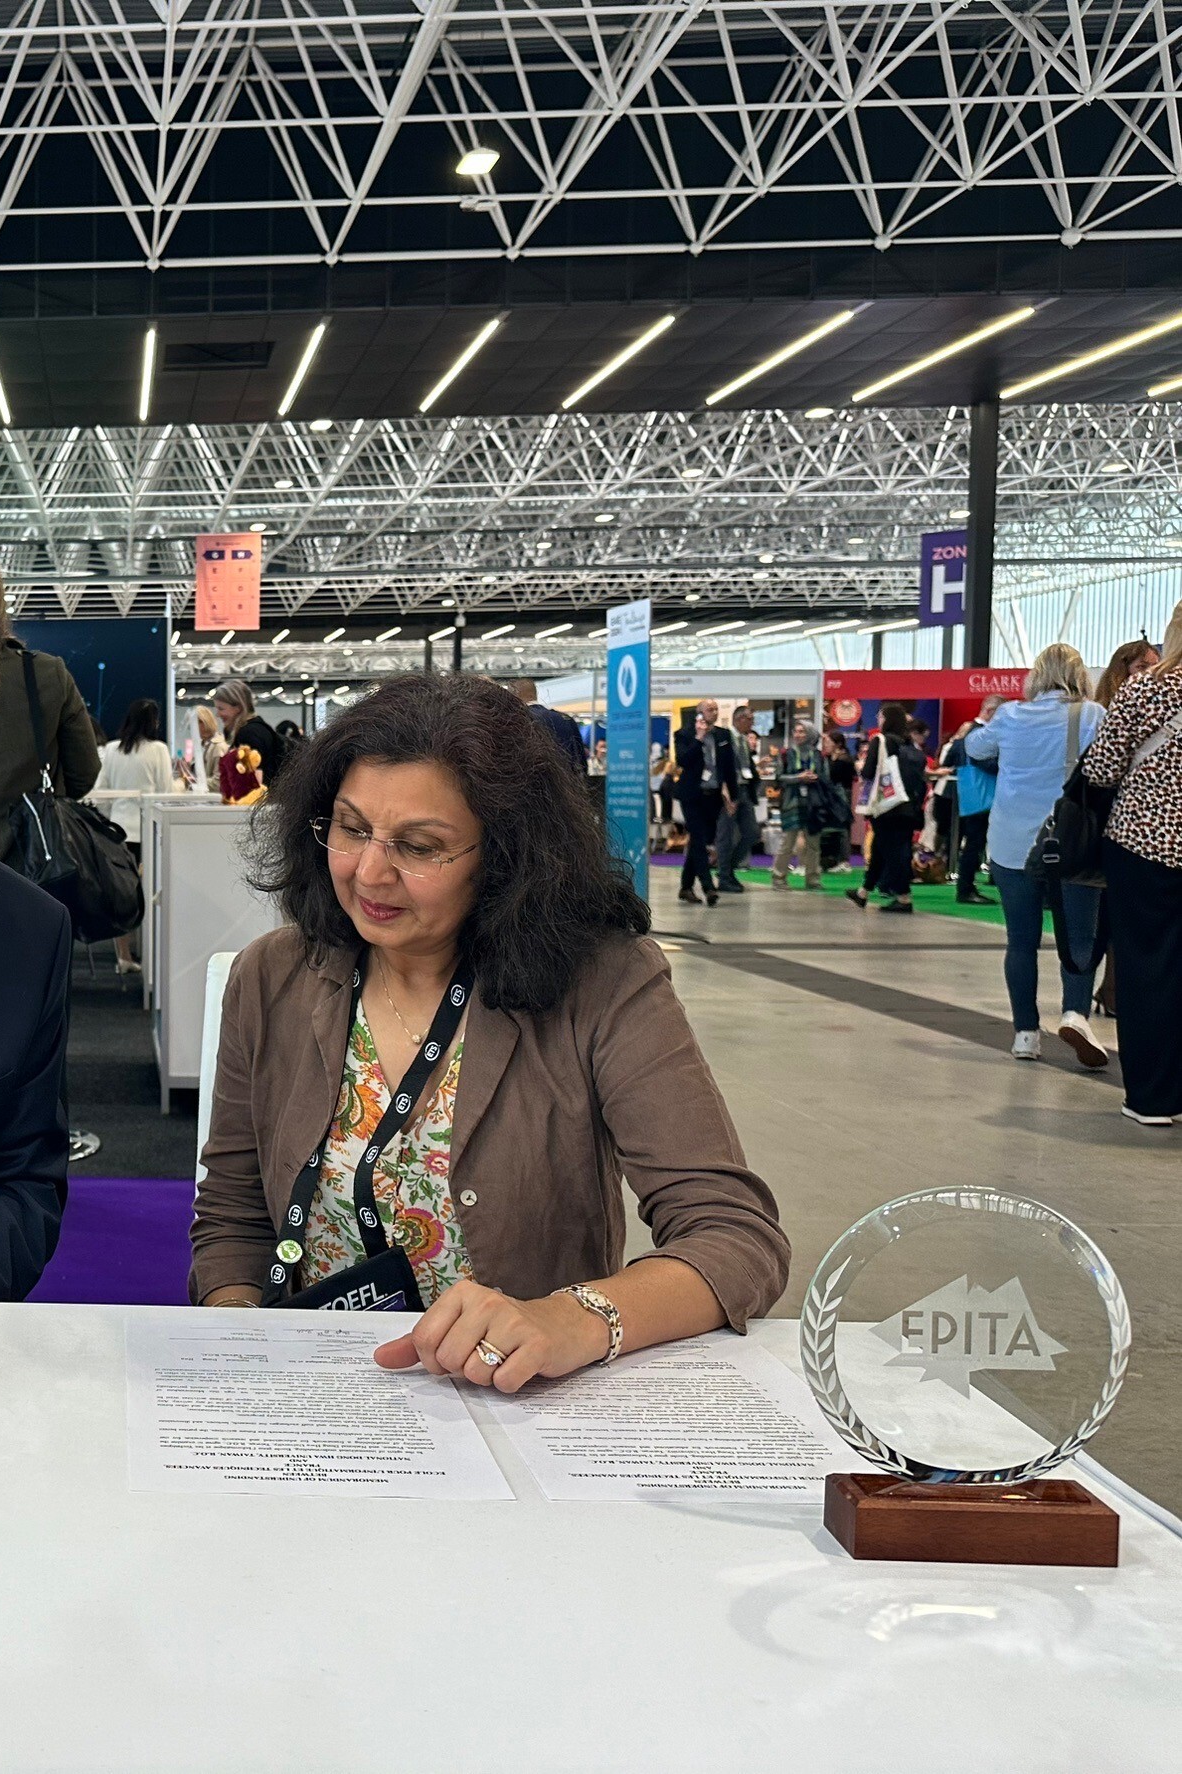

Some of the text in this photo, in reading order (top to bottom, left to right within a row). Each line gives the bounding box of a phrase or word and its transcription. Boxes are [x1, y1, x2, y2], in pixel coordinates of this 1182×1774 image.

[931, 563, 967, 613] H
[969, 674, 1021, 688] CLARK
[901, 1310, 1041, 1357] EPITA
